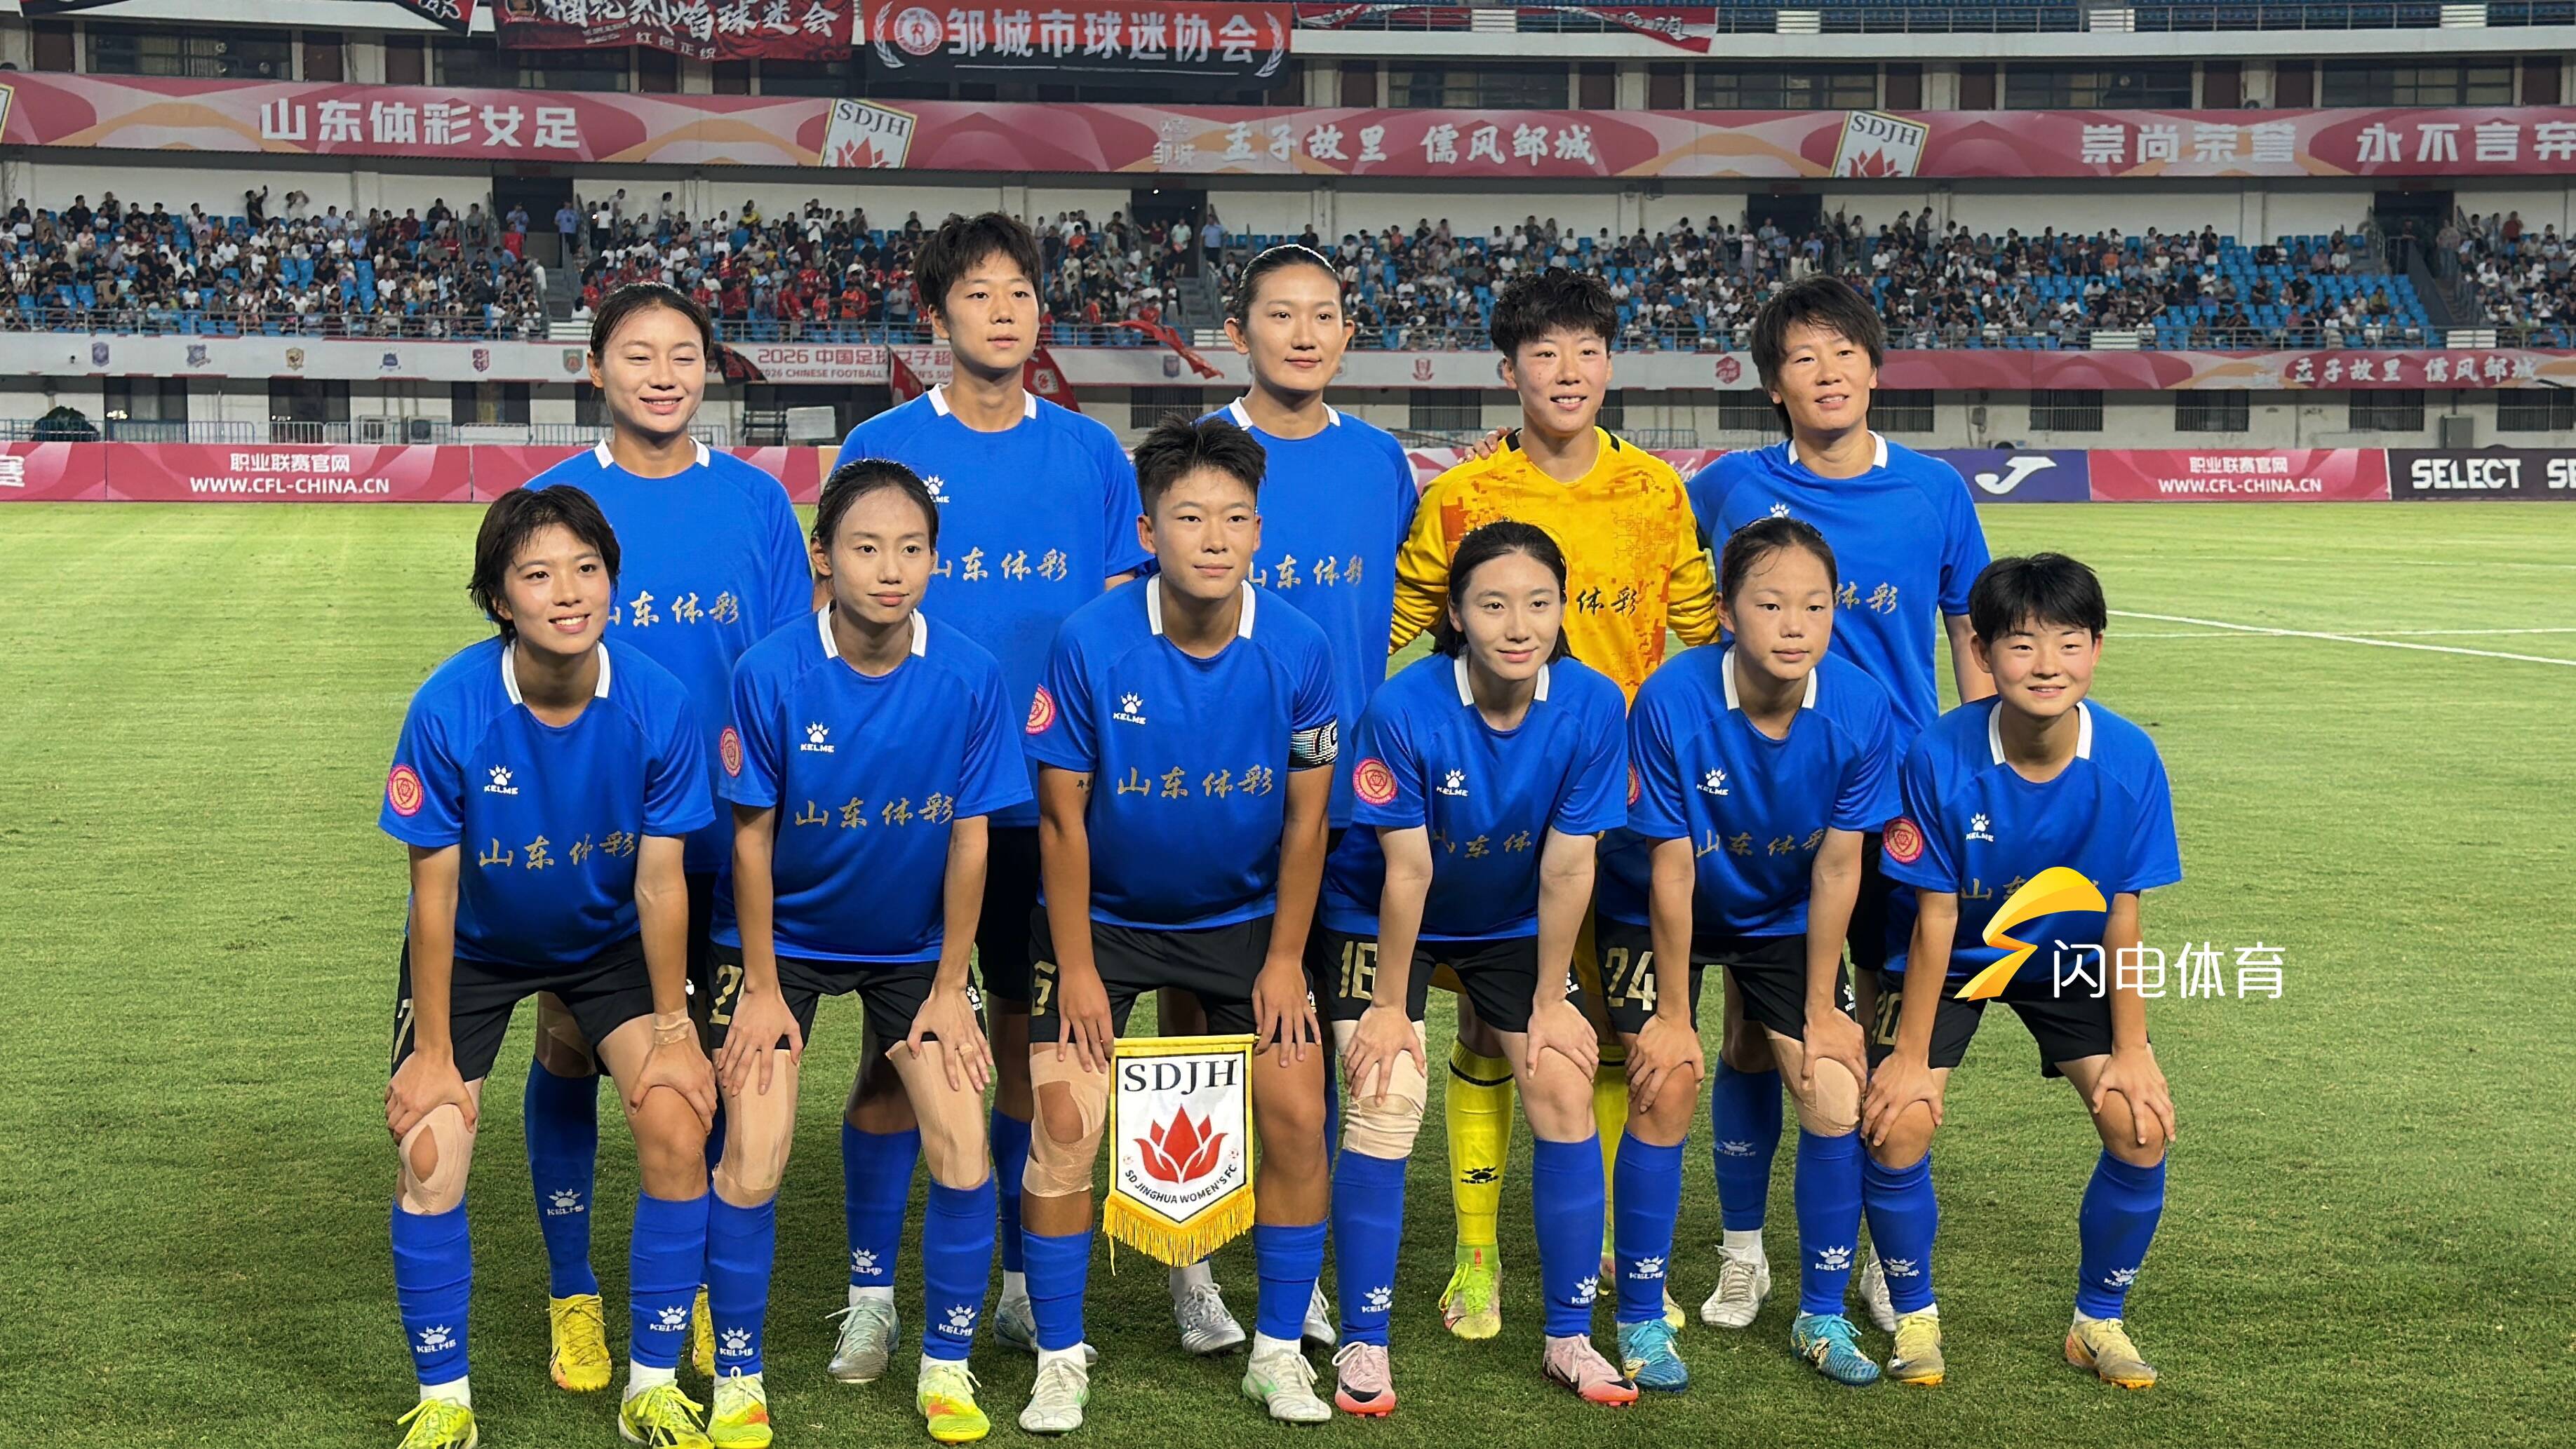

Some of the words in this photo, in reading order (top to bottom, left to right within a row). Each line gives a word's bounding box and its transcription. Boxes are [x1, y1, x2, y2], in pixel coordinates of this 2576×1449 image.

[946, 8, 1257, 64] 邹城市球迷协会
[262, 98, 579, 149] 山东体彩女足
[836, 102, 906, 137] SDJH
[1851, 114, 1918, 147] SDJH
[2081, 123, 2296, 163] 崇尚荣誉
[2356, 122, 2576, 163] 永不言弃
[758, 349, 809, 364] 2026
[786, 368, 828, 378] CHINESE
[831, 368, 883, 378] FOOTBALL
[230, 453, 349, 473] 职业联赛官网
[2189, 457, 2288, 473] 职业联赛官网
[2411, 458, 2521, 489] SELECT
[189, 477, 389, 494] WWW.CFL-CHINA.CN
[2158, 478, 2322, 493] WWW.CFL-CHINA.CN
[1113, 713, 1146, 724] KELME
[800, 743, 835, 753] KELME
[1118, 764, 1274, 798] 山东体彩
[1696, 783, 1729, 795] KELME
[484, 785, 518, 795] KELME
[1436, 786, 1468, 797] KELME
[796, 792, 955, 828] 山东体彩
[1966, 832, 1994, 842] KELME
[478, 830, 636, 870] 山东体彩
[1605, 948, 1657, 1011] 24
[1124, 1059, 1237, 1096] SDJH
[1125, 1169, 1138, 1183] SD
[1134, 1181, 1178, 1204] JINGHUA
[1179, 1178, 1227, 1204] WOMEN'S
[1226, 1164, 1237, 1179] FC
[546, 1204, 584, 1216] KELME
[415, 1339, 456, 1354] KELME
[719, 1347, 754, 1357] KELME
